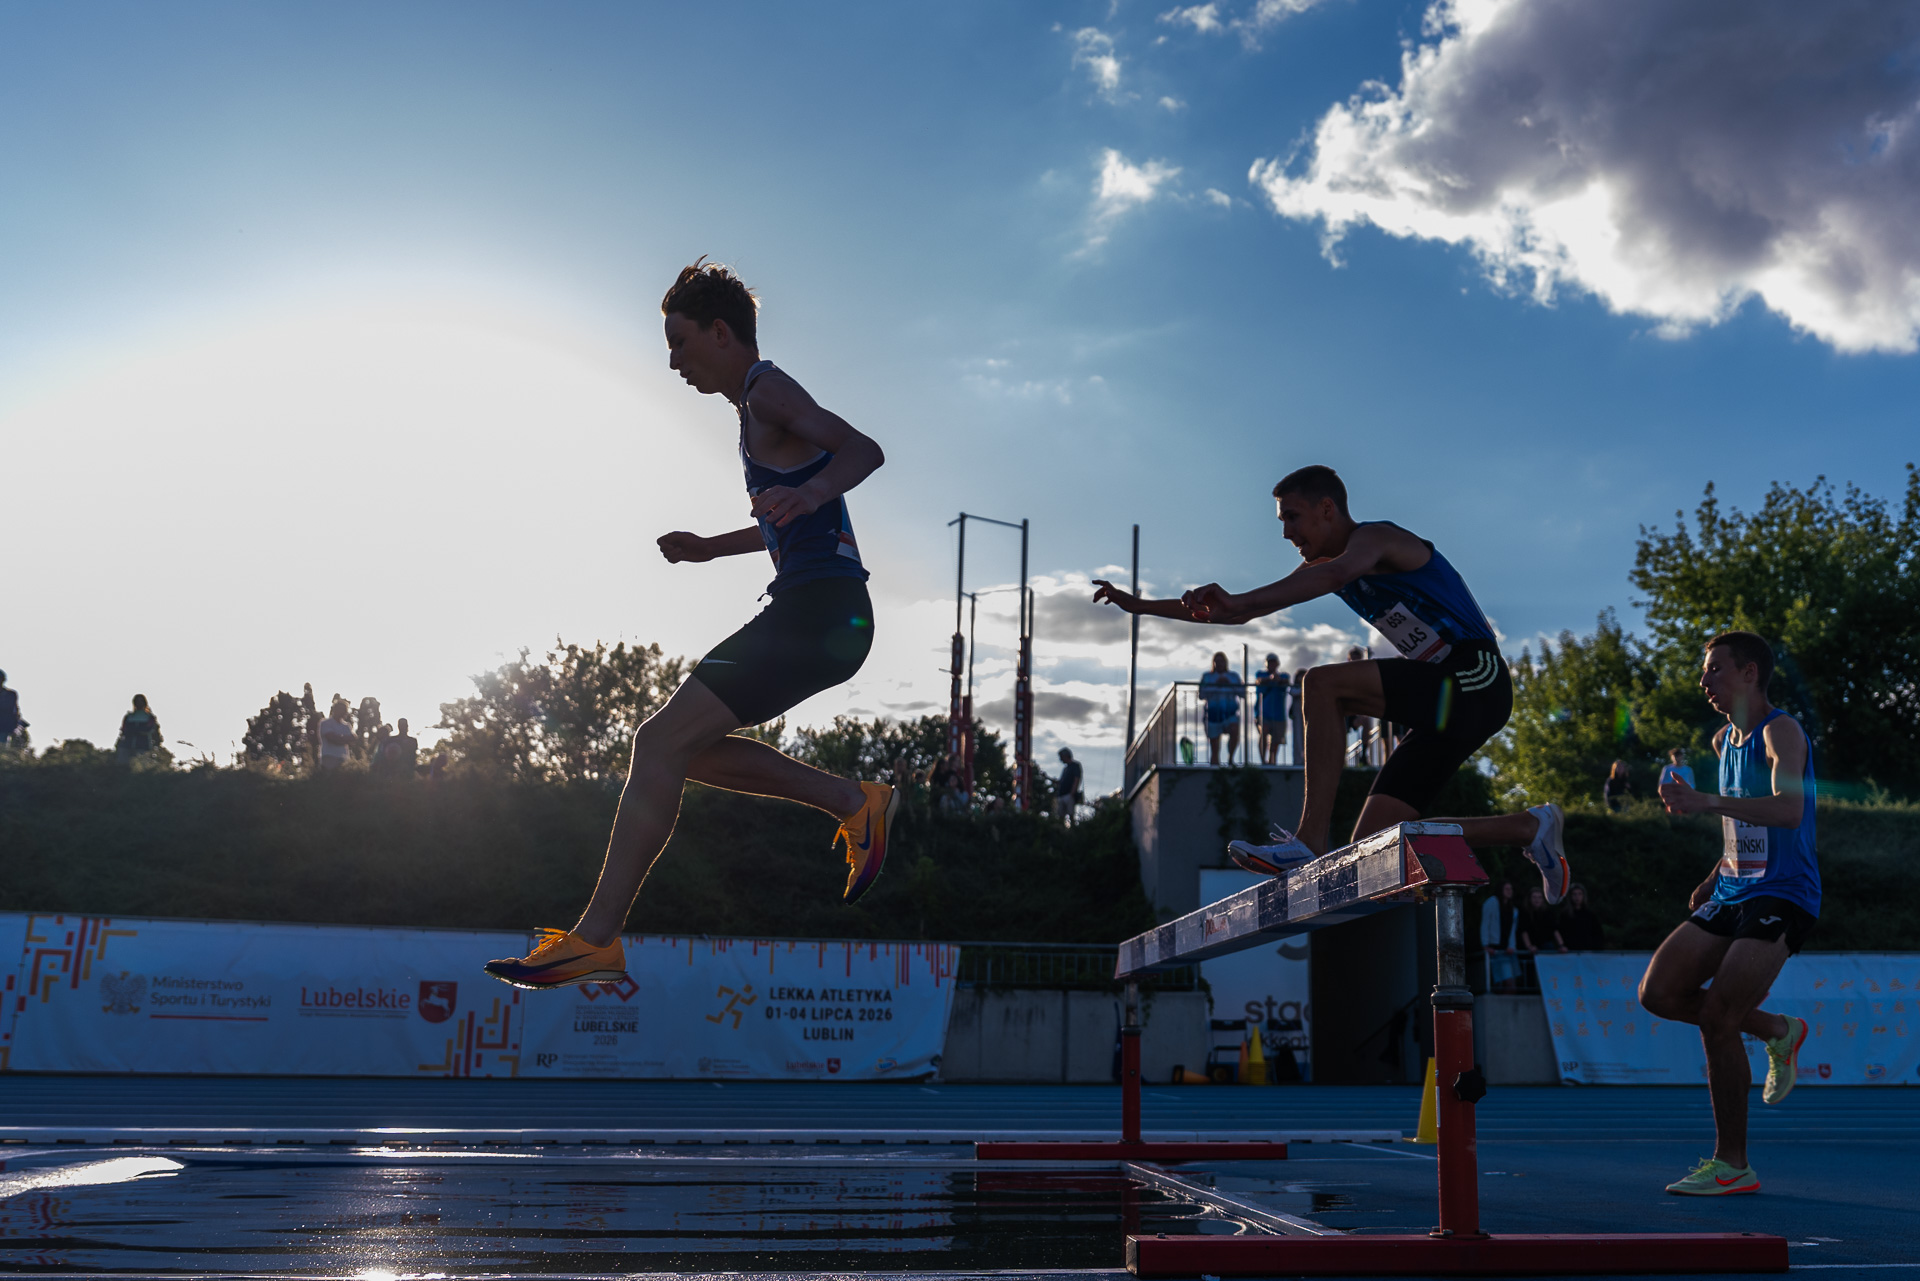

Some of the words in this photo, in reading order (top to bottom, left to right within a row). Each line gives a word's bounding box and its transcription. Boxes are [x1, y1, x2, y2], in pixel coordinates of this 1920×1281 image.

[1387, 611, 1407, 628] 653
[1397, 626, 1428, 655] ALAS
[152, 976, 243, 991] Ministerstwo
[150, 991, 197, 1008] Sportu
[200, 993, 206, 1006] i
[209, 993, 272, 1009] Turystyki
[300, 986, 411, 1009] Lubelskie
[769, 987, 815, 1001] LEKKA
[820, 988, 892, 1002] ATLETYKA
[765, 1006, 806, 1020] 01-04
[811, 1008, 854, 1021] LIPCA
[858, 1008, 893, 1021] 2026
[574, 1021, 639, 1032] LUBELSKIE
[803, 1027, 854, 1041] LUBLIN
[593, 1035, 618, 1046] 2026
[536, 1052, 558, 1067] RP
